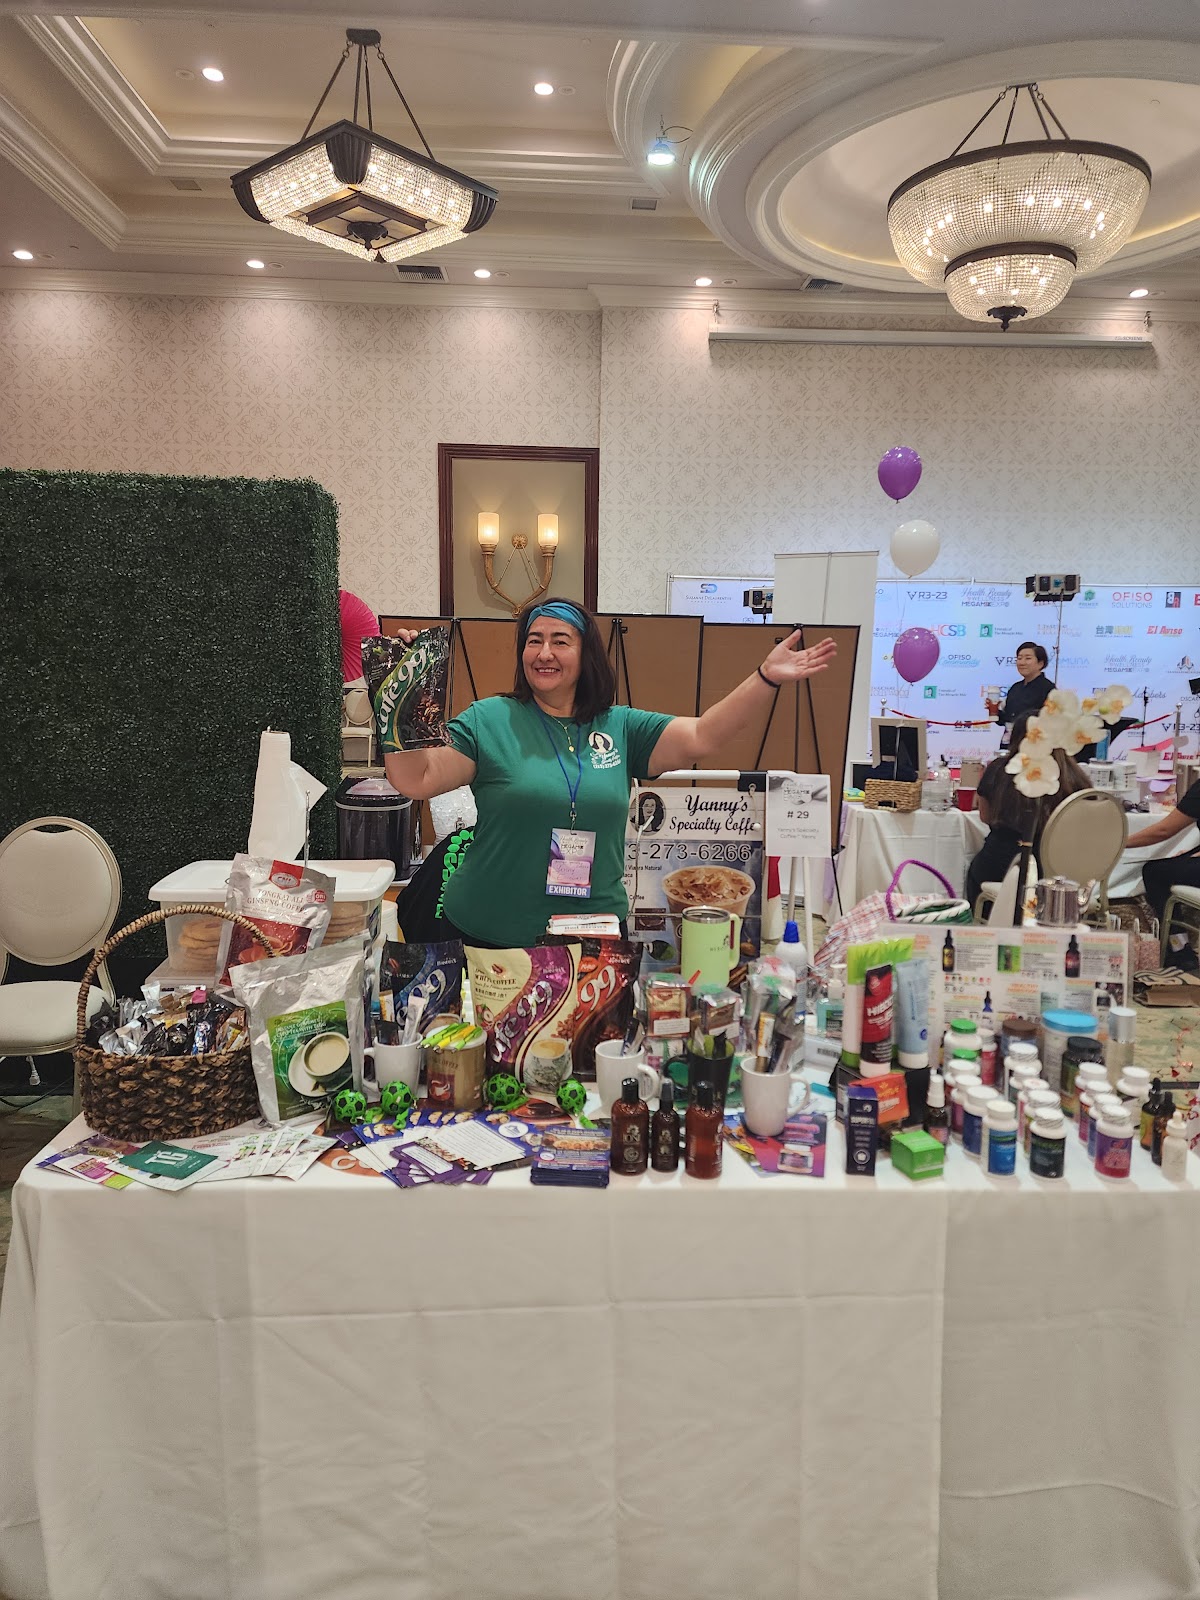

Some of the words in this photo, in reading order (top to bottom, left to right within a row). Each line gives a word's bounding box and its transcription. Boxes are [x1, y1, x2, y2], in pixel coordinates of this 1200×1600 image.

[1112, 592, 1152, 602] OFISO
[684, 794, 748, 816] Yanny's
[669, 816, 722, 834] Specialty
[549, 886, 587, 896] EXHIBITOR
